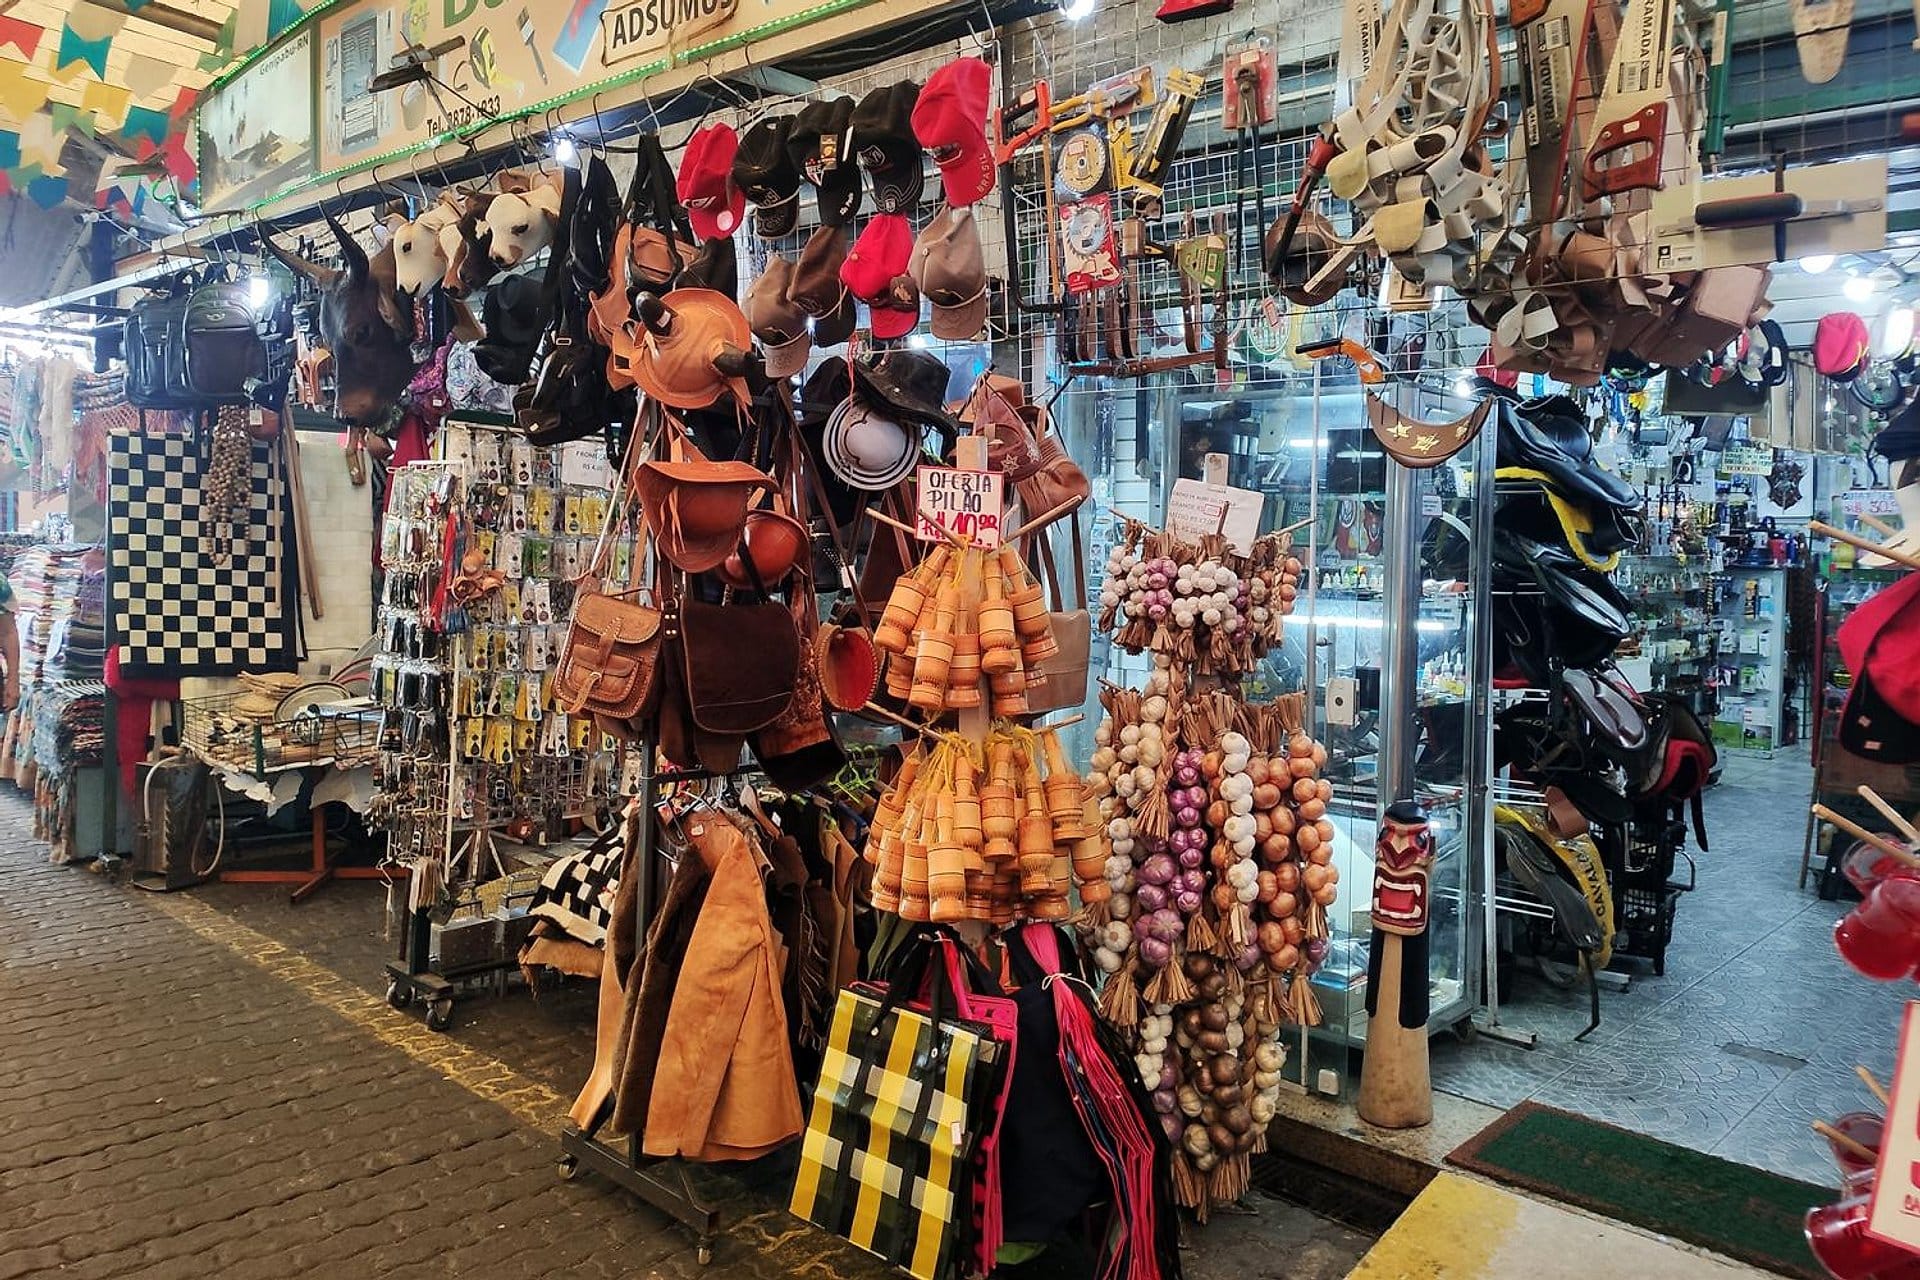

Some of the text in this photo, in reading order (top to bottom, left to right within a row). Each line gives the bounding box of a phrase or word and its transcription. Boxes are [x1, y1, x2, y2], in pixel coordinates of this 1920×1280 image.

[1361, 22, 1370, 72] RAMADA
[1540, 55, 1556, 121] RAMADA
[976, 153, 990, 193] BRASIL
[929, 471, 991, 492] OFERTA
